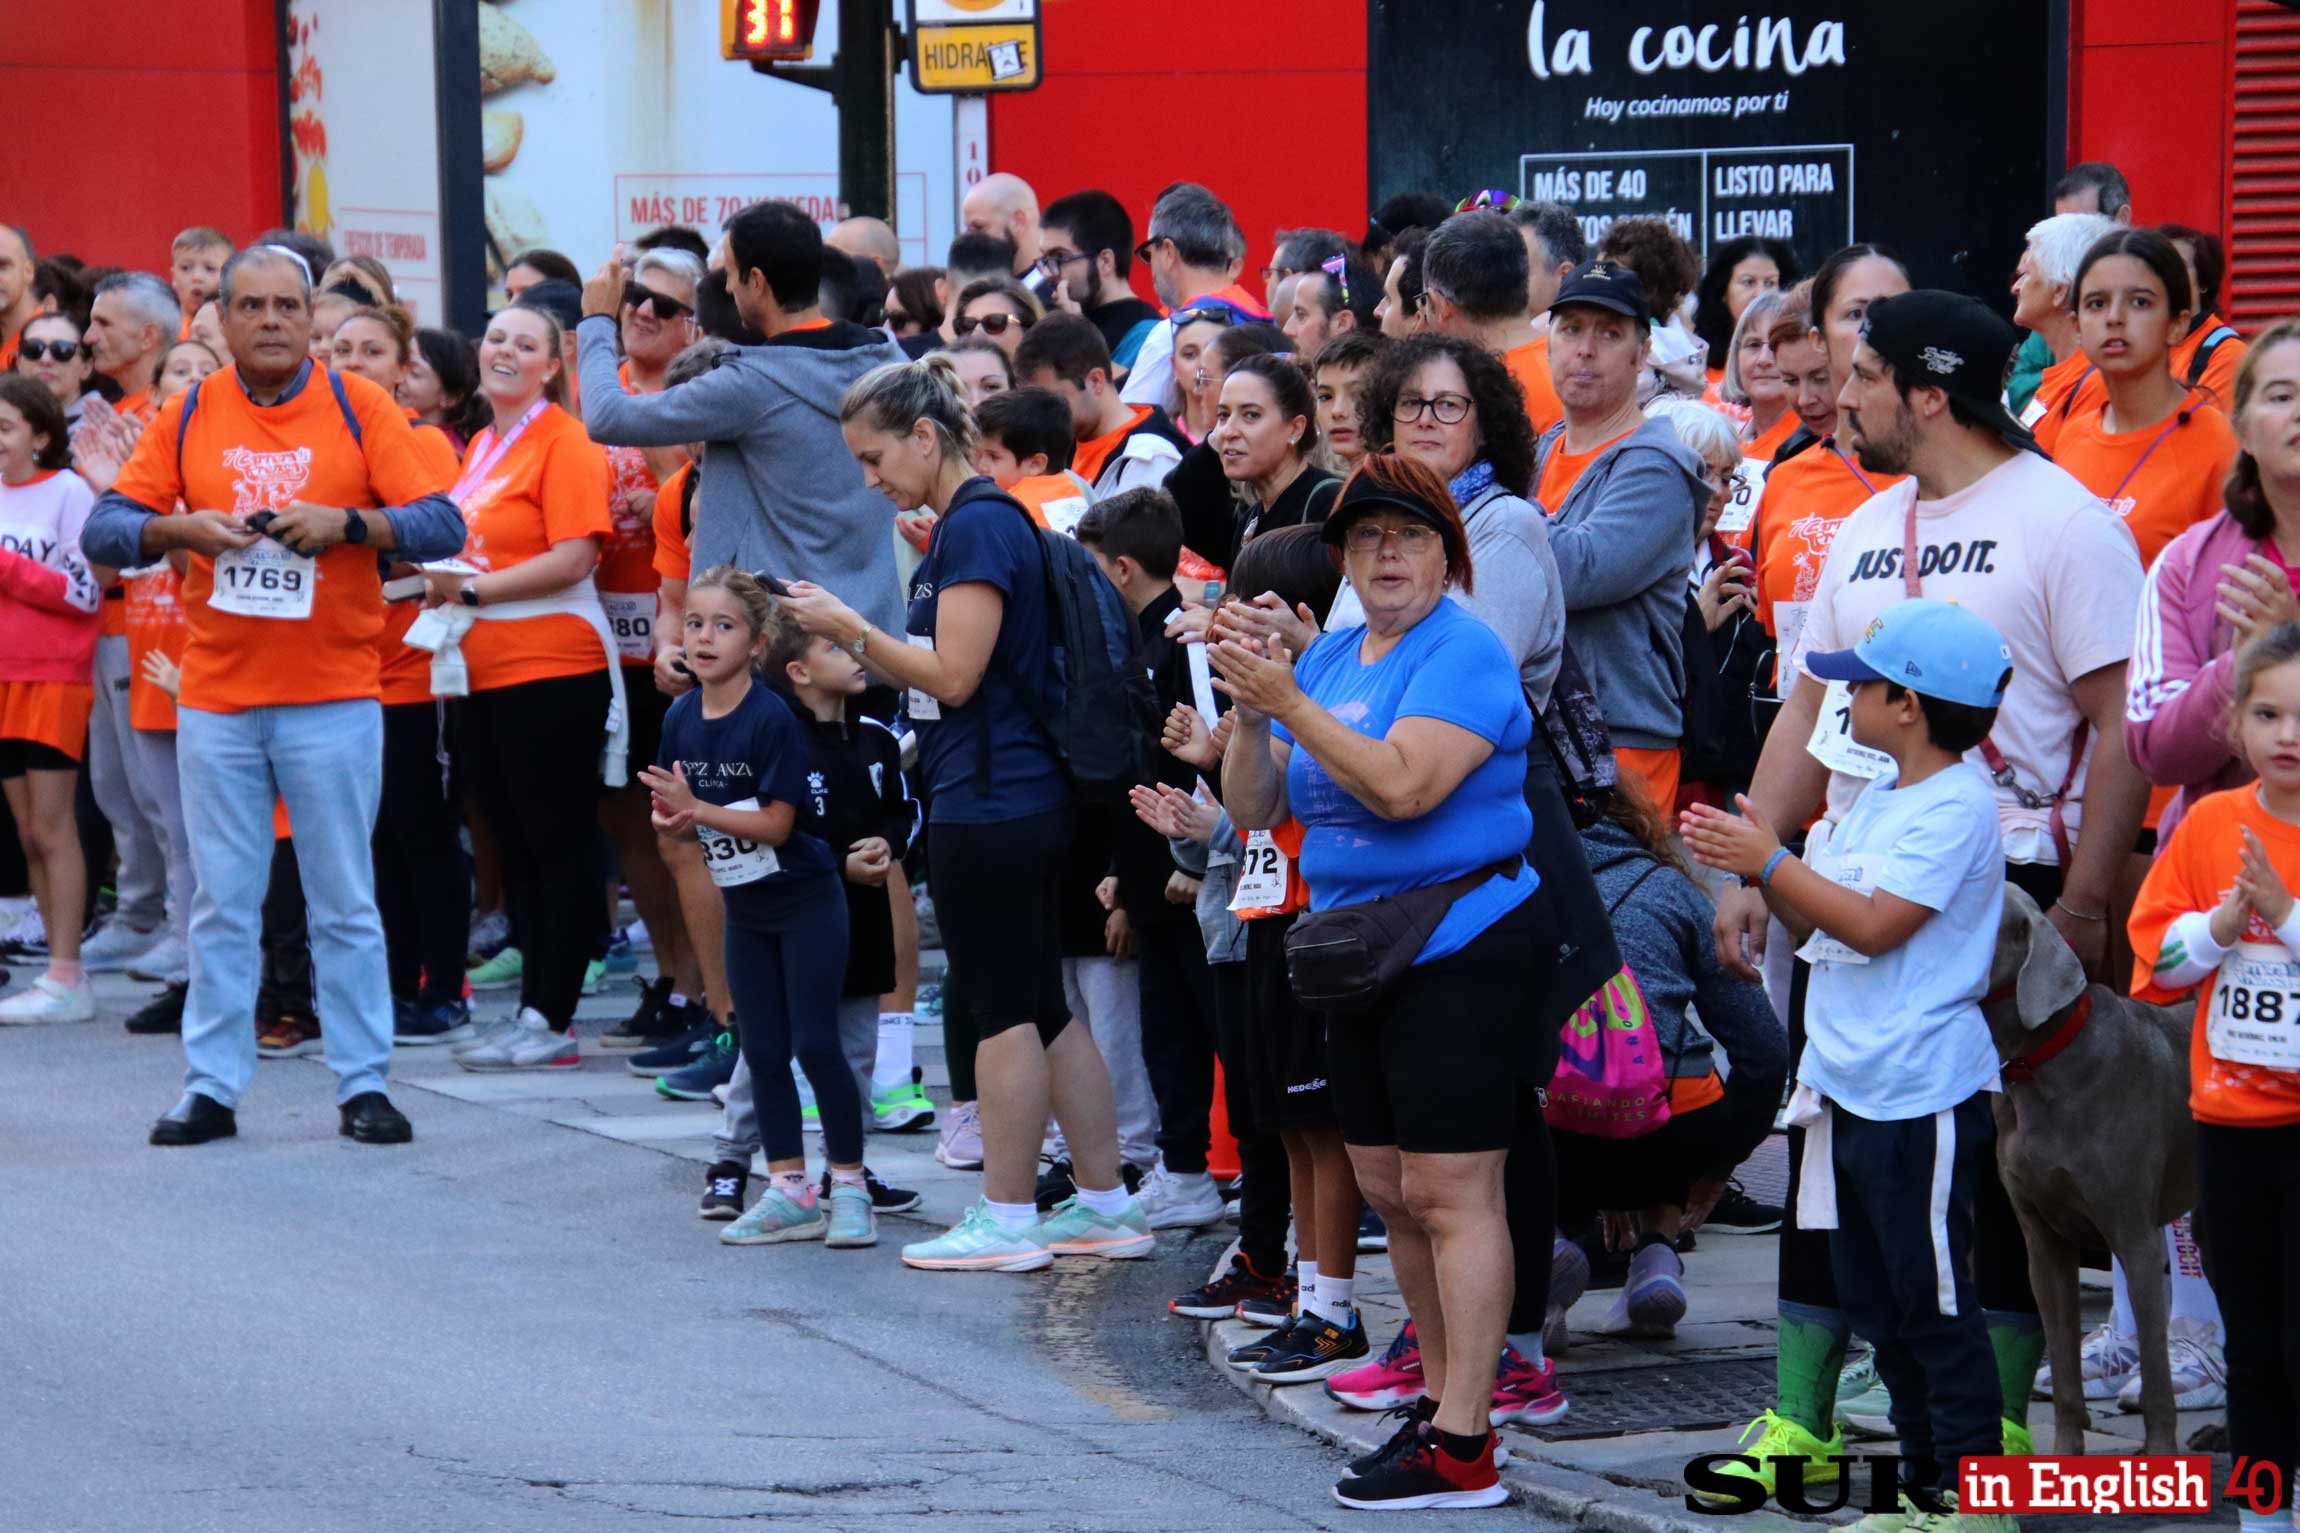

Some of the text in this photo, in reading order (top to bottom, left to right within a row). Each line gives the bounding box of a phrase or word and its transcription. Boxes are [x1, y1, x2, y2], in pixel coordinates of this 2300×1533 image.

[746, 0, 794, 46] 31
[1528, 0, 1847, 79] la cocina
[924, 39, 1028, 70] HIDRAE
[1584, 90, 1790, 122] Hoy cocinamos por ti
[1534, 166, 1648, 201] MÁS DE 40
[1714, 163, 1835, 197] LISTO PARA
[631, 191, 676, 225] MÁS
[683, 196, 710, 225] DE
[1714, 208, 1794, 242] LLEVAR
[1918, 541, 1962, 578] DO
[223, 565, 302, 591] 1769
[814, 797, 826, 816] 3
[1243, 847, 1278, 875] 72
